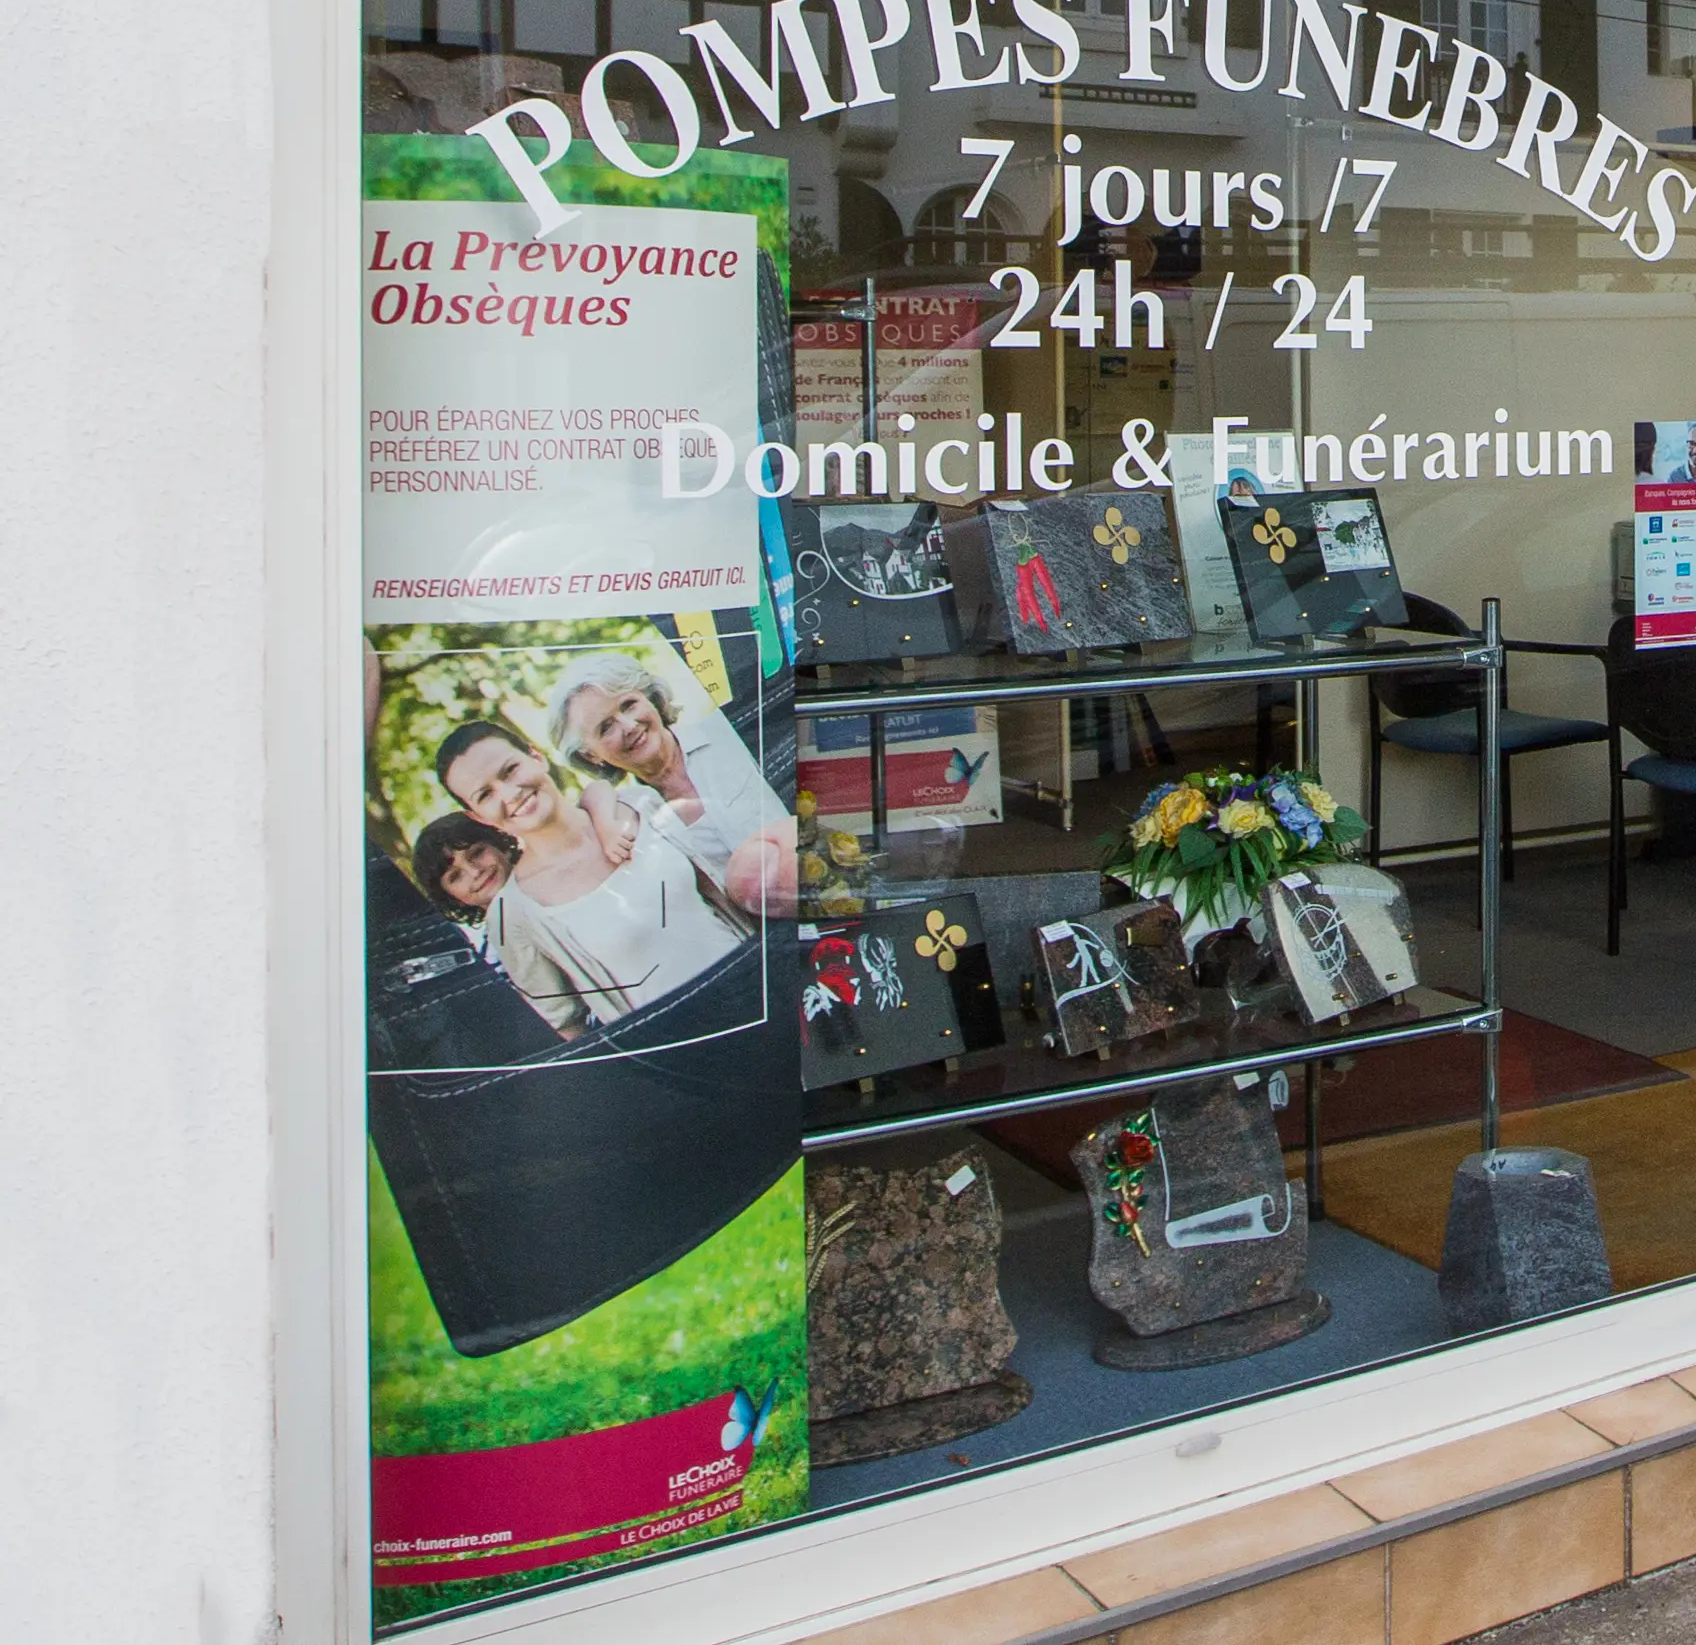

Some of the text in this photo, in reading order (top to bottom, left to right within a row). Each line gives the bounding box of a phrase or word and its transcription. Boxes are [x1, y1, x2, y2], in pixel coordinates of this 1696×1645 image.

[961, 134, 1398, 246] 7 jours /7
[367, 230, 739, 285] La Prévoyance
[370, 282, 632, 337] Obsèques
[989, 260, 1373, 350] 24h / 24
[799, 324, 961, 345] OBSQUES
[898, 357, 906, 367] 4
[911, 355, 969, 367] millions
[795, 393, 852, 403] contrat
[930, 392, 951, 403] afin
[954, 392, 970, 403] de
[369, 409, 429, 432] POUR
[437, 406, 554, 432] ÉPARGNEZ
[560, 409, 603, 431] VOS
[369, 436, 480, 463] PRÉFÉREZ
[488, 440, 519, 462] UN
[528, 438, 626, 461] CONTRAT
[660, 408, 1614, 499] Domicile & Funérarium
[369, 465, 544, 493] PERSONNALISÉ.
[372, 565, 746, 599] RENSEIGNEMENTS ET DEVIS GRATUIT ICI.
[669, 1465, 744, 1502] FUNERAIRE
[620, 1495, 740, 1545] LE CHOIX DE LA VIE
